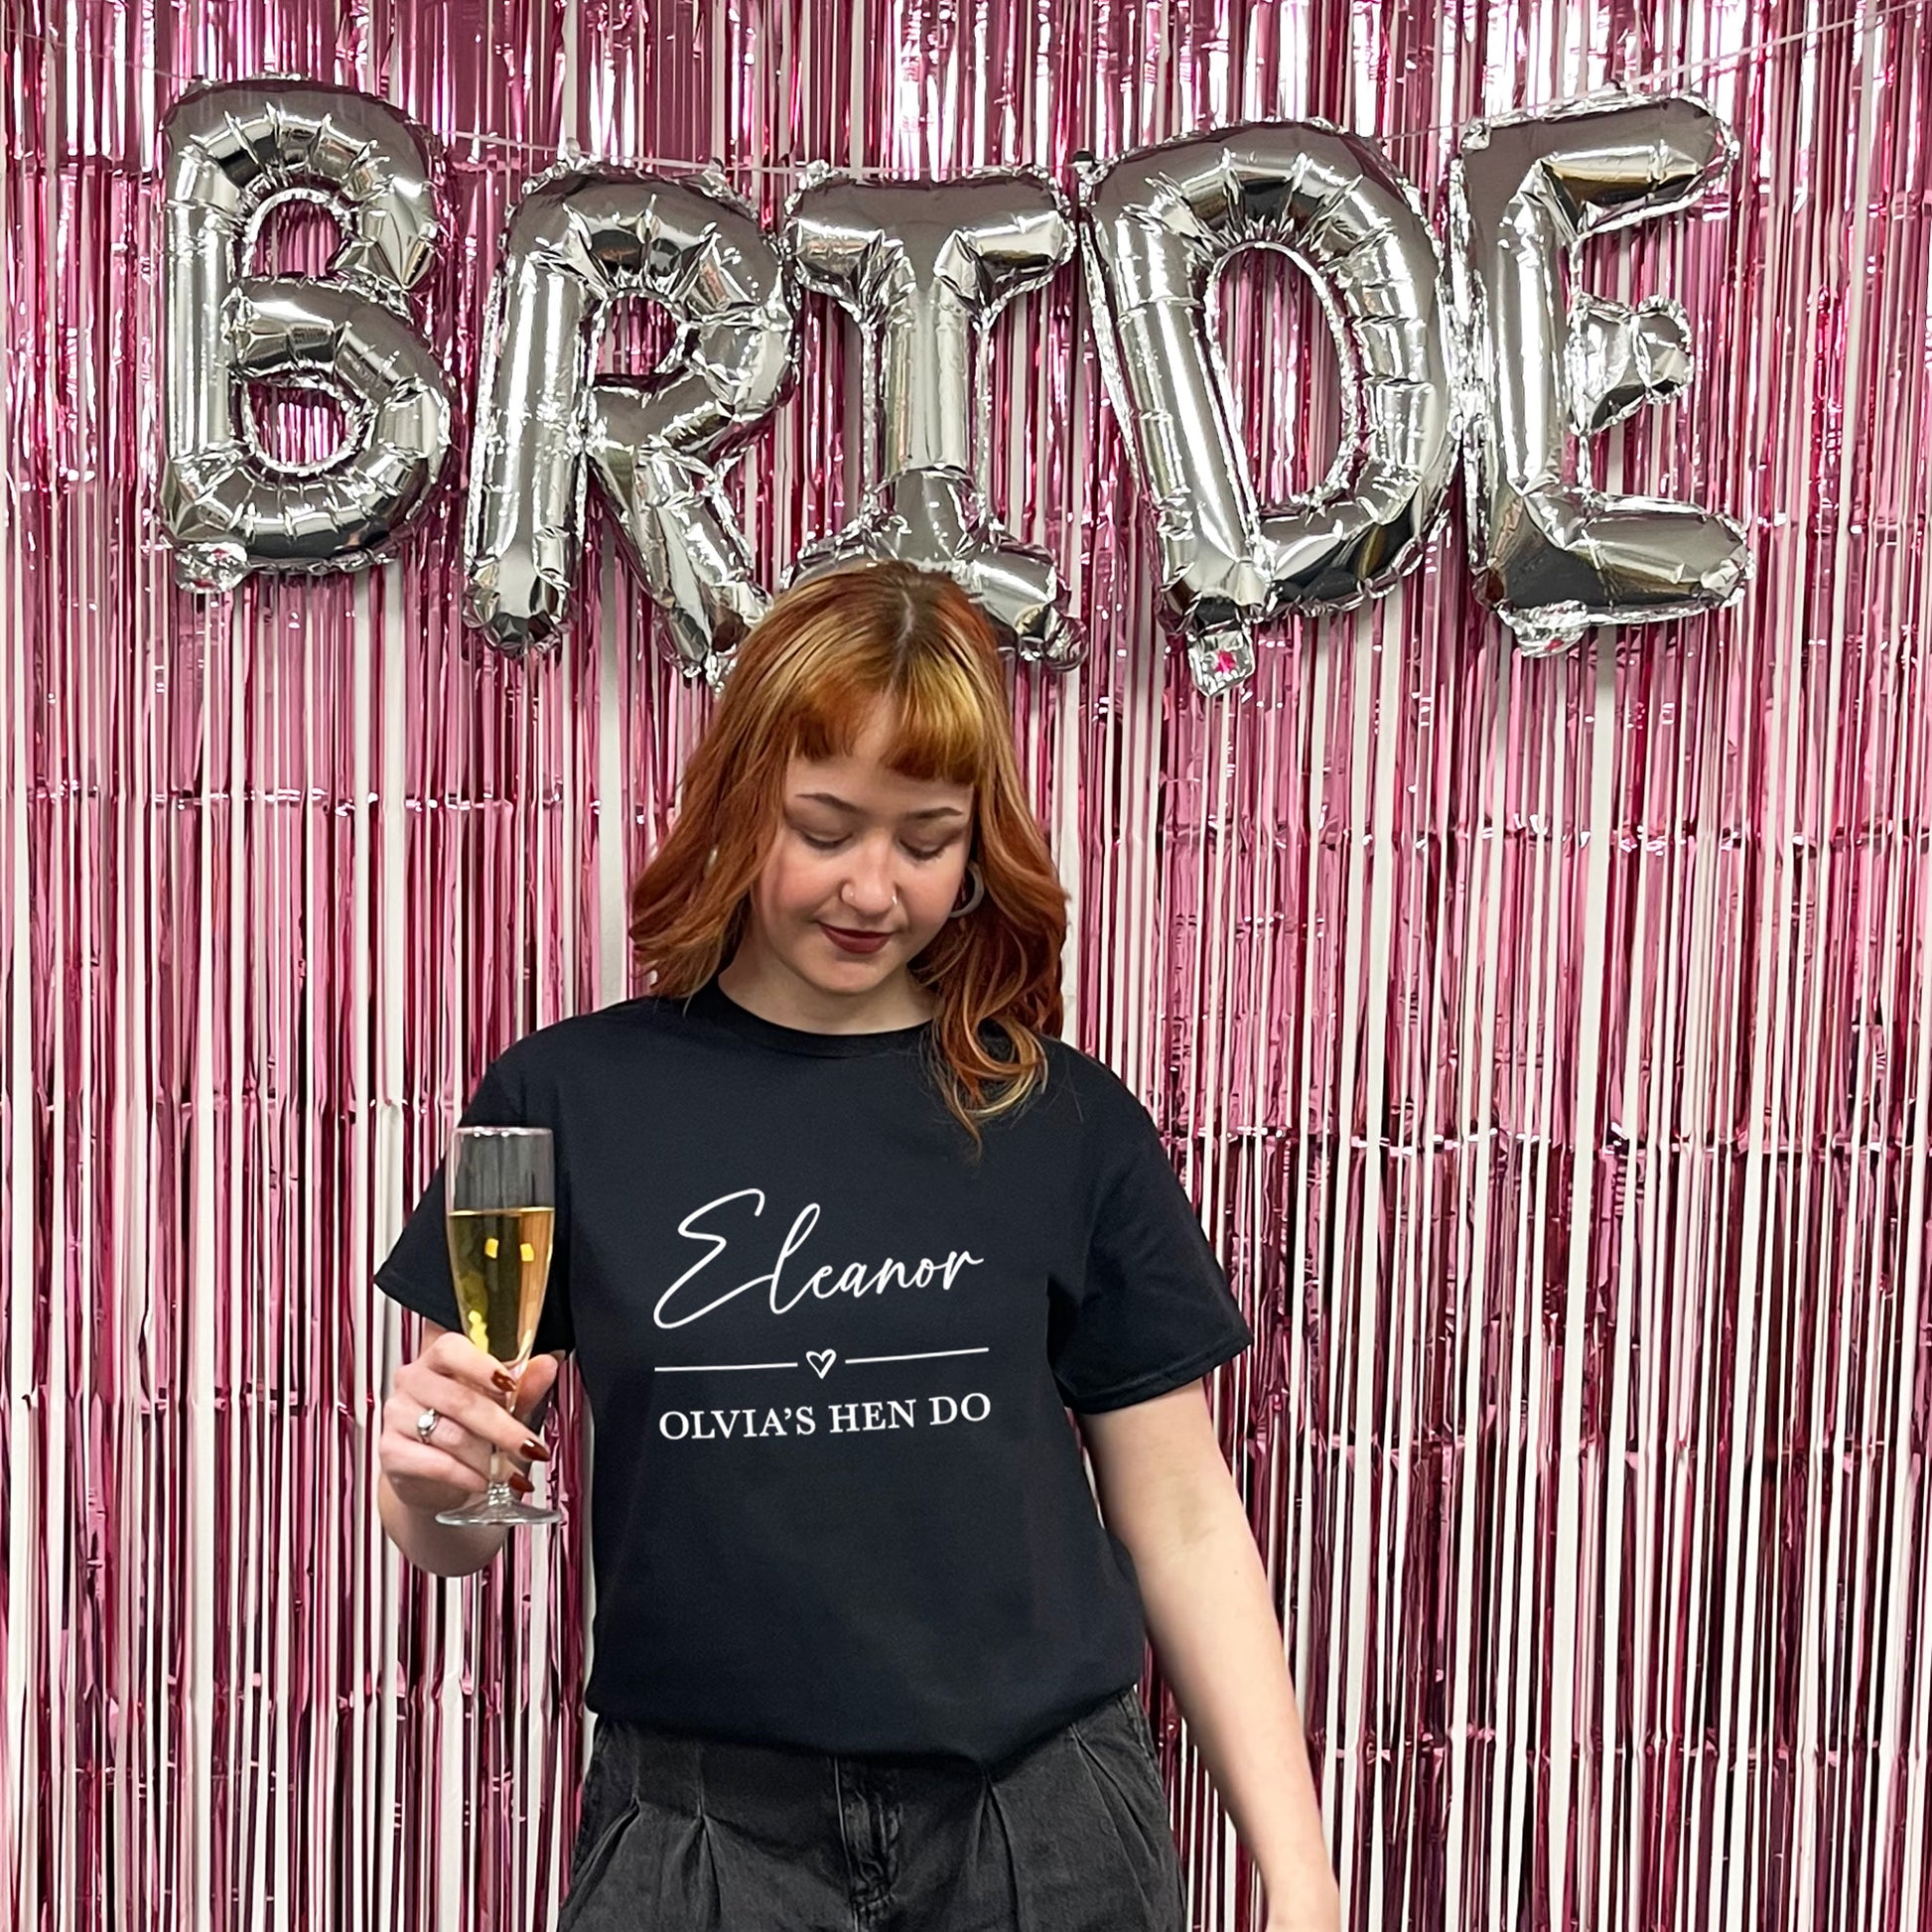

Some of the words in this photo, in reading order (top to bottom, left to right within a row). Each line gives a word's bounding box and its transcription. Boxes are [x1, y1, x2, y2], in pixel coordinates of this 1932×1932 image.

[160, 75, 1755, 691] BRIDE
[653, 1188, 985, 1329] Eleanor
[658, 1406, 816, 1441] OLVIA'S
[827, 1399, 917, 1434] HEN
[928, 1392, 992, 1426] DO
